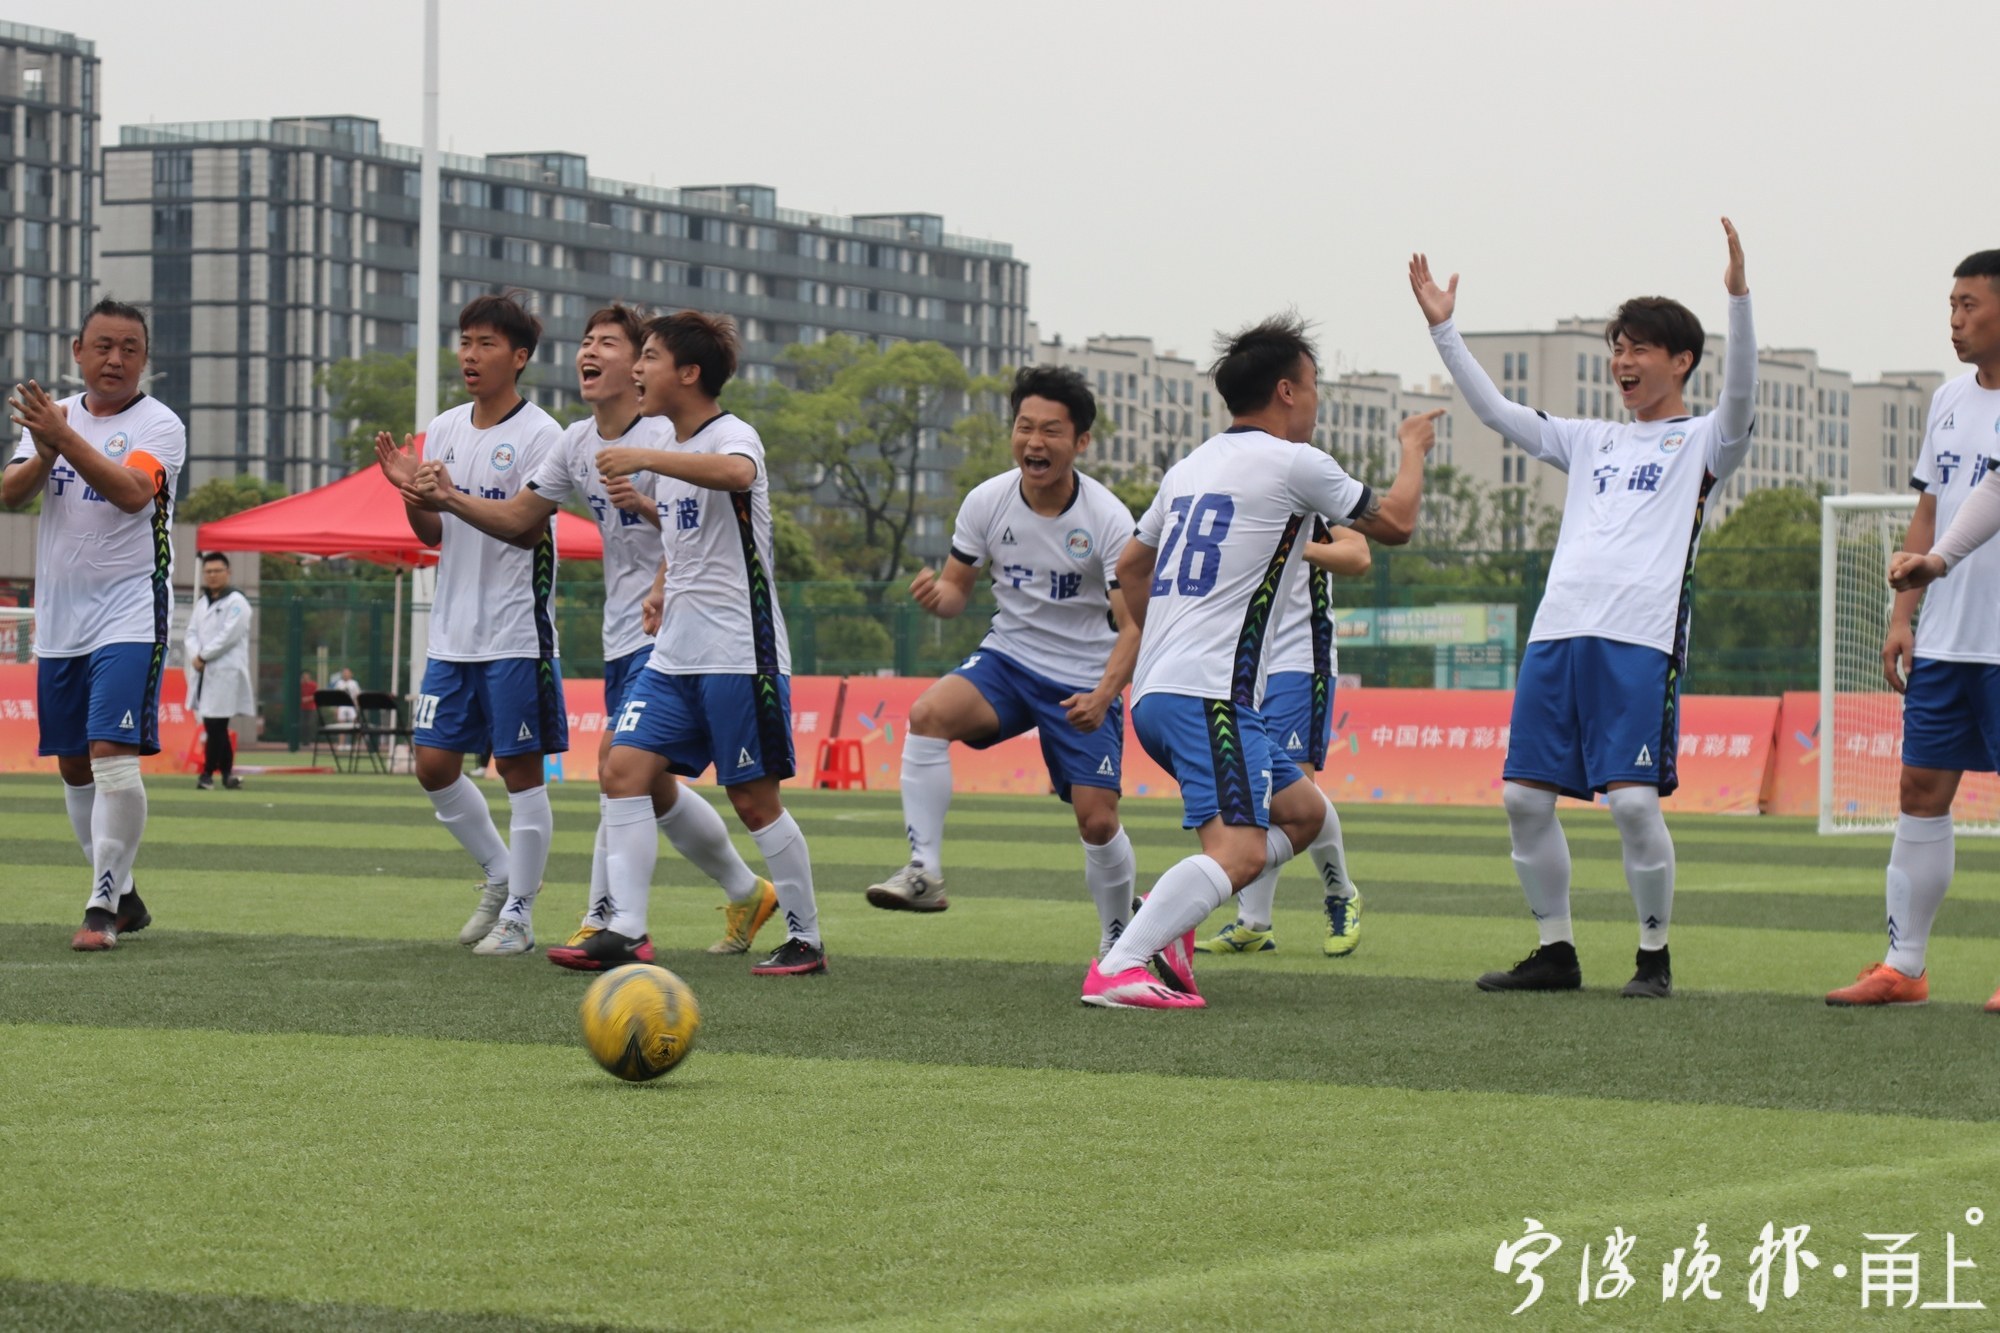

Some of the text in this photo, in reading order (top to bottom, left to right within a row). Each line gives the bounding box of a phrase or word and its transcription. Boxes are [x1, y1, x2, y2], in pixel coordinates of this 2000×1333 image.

[1593, 463, 1663, 495] 宁波
[1150, 493, 1235, 598] 28
[1003, 565, 1082, 600] 宁波
[0, 699, 37, 721] 彩票
[1848, 733, 1905, 758] 中国
